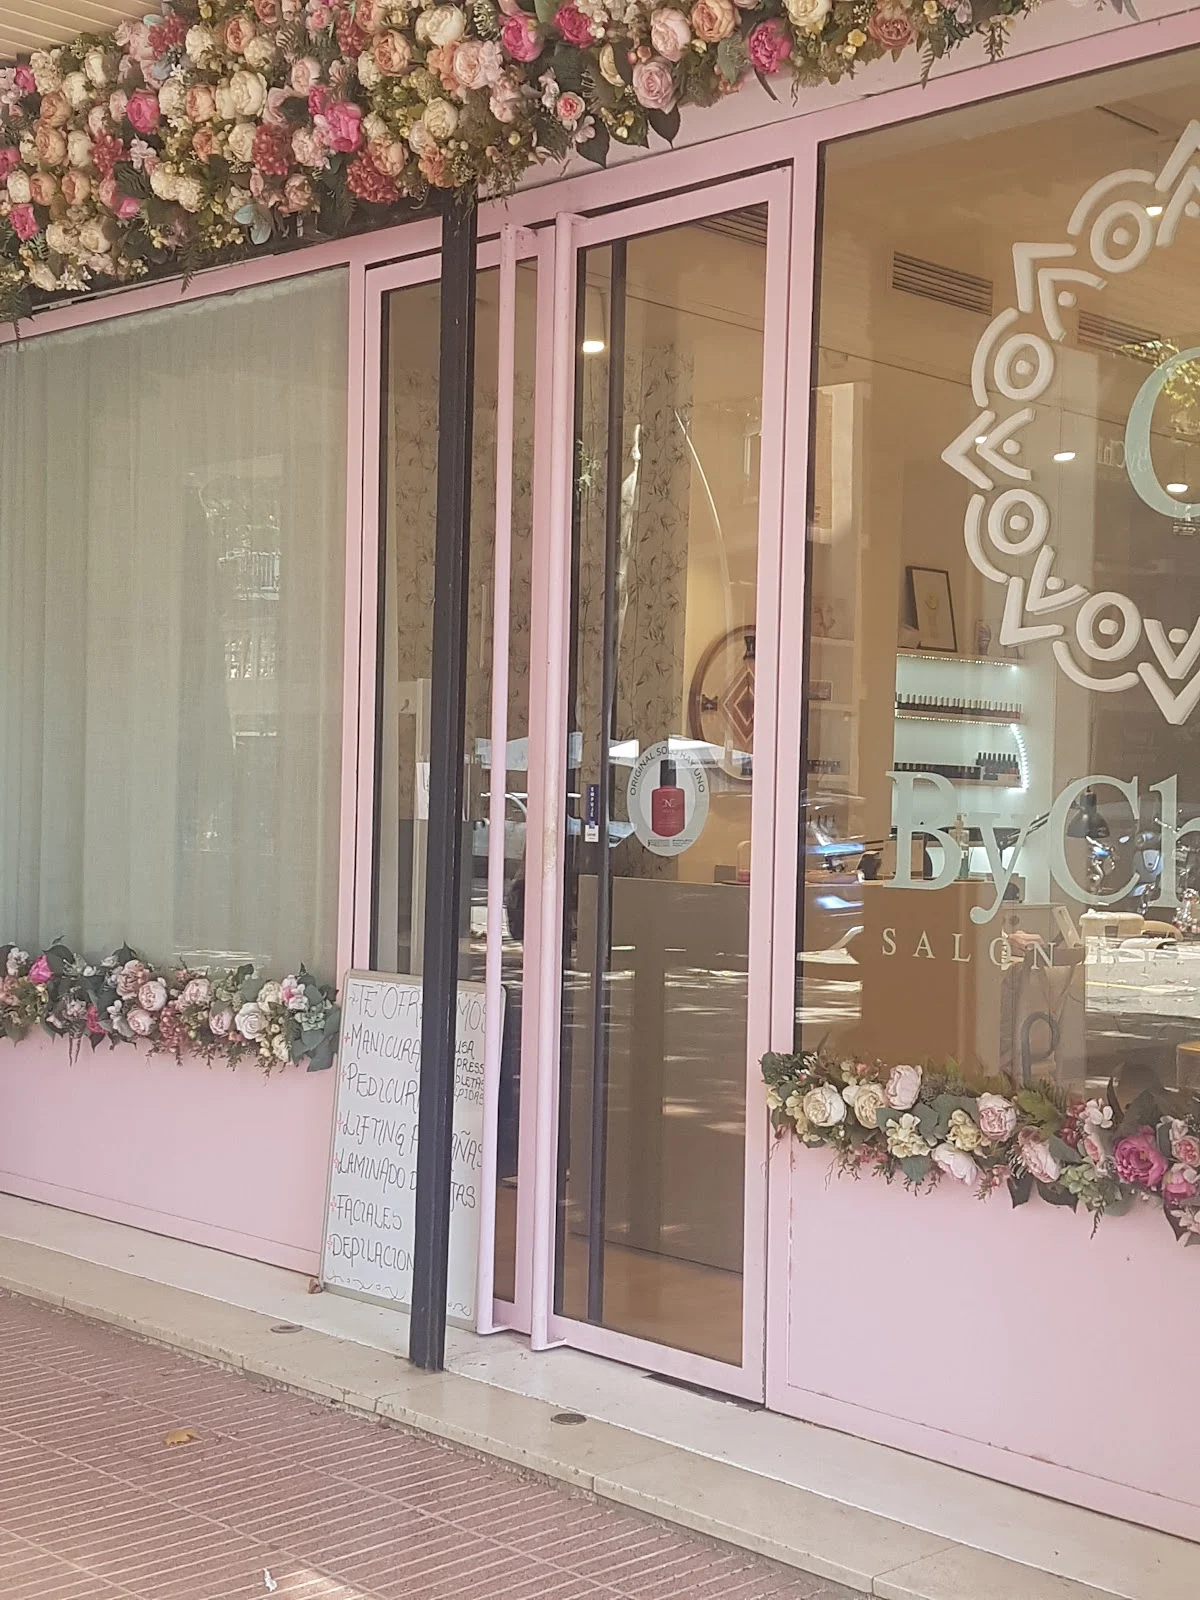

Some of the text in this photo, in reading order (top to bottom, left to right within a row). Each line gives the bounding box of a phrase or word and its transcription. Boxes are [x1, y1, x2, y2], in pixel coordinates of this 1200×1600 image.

[630, 752, 656, 796] ORIGINAL
[656, 746, 678, 757] SOLO
[693, 768, 705, 793] UNO
[881, 927, 1057, 970] SALON
[353, 983, 379, 1018] TE
[350, 1022, 421, 1073] MANICURA
[346, 1062, 420, 1114] PEDICUR
[342, 1109, 406, 1156] LIFTING
[337, 1148, 406, 1194] LAMINADO
[336, 1194, 402, 1230] FACIALES
[330, 1233, 415, 1271] DEPILACION
